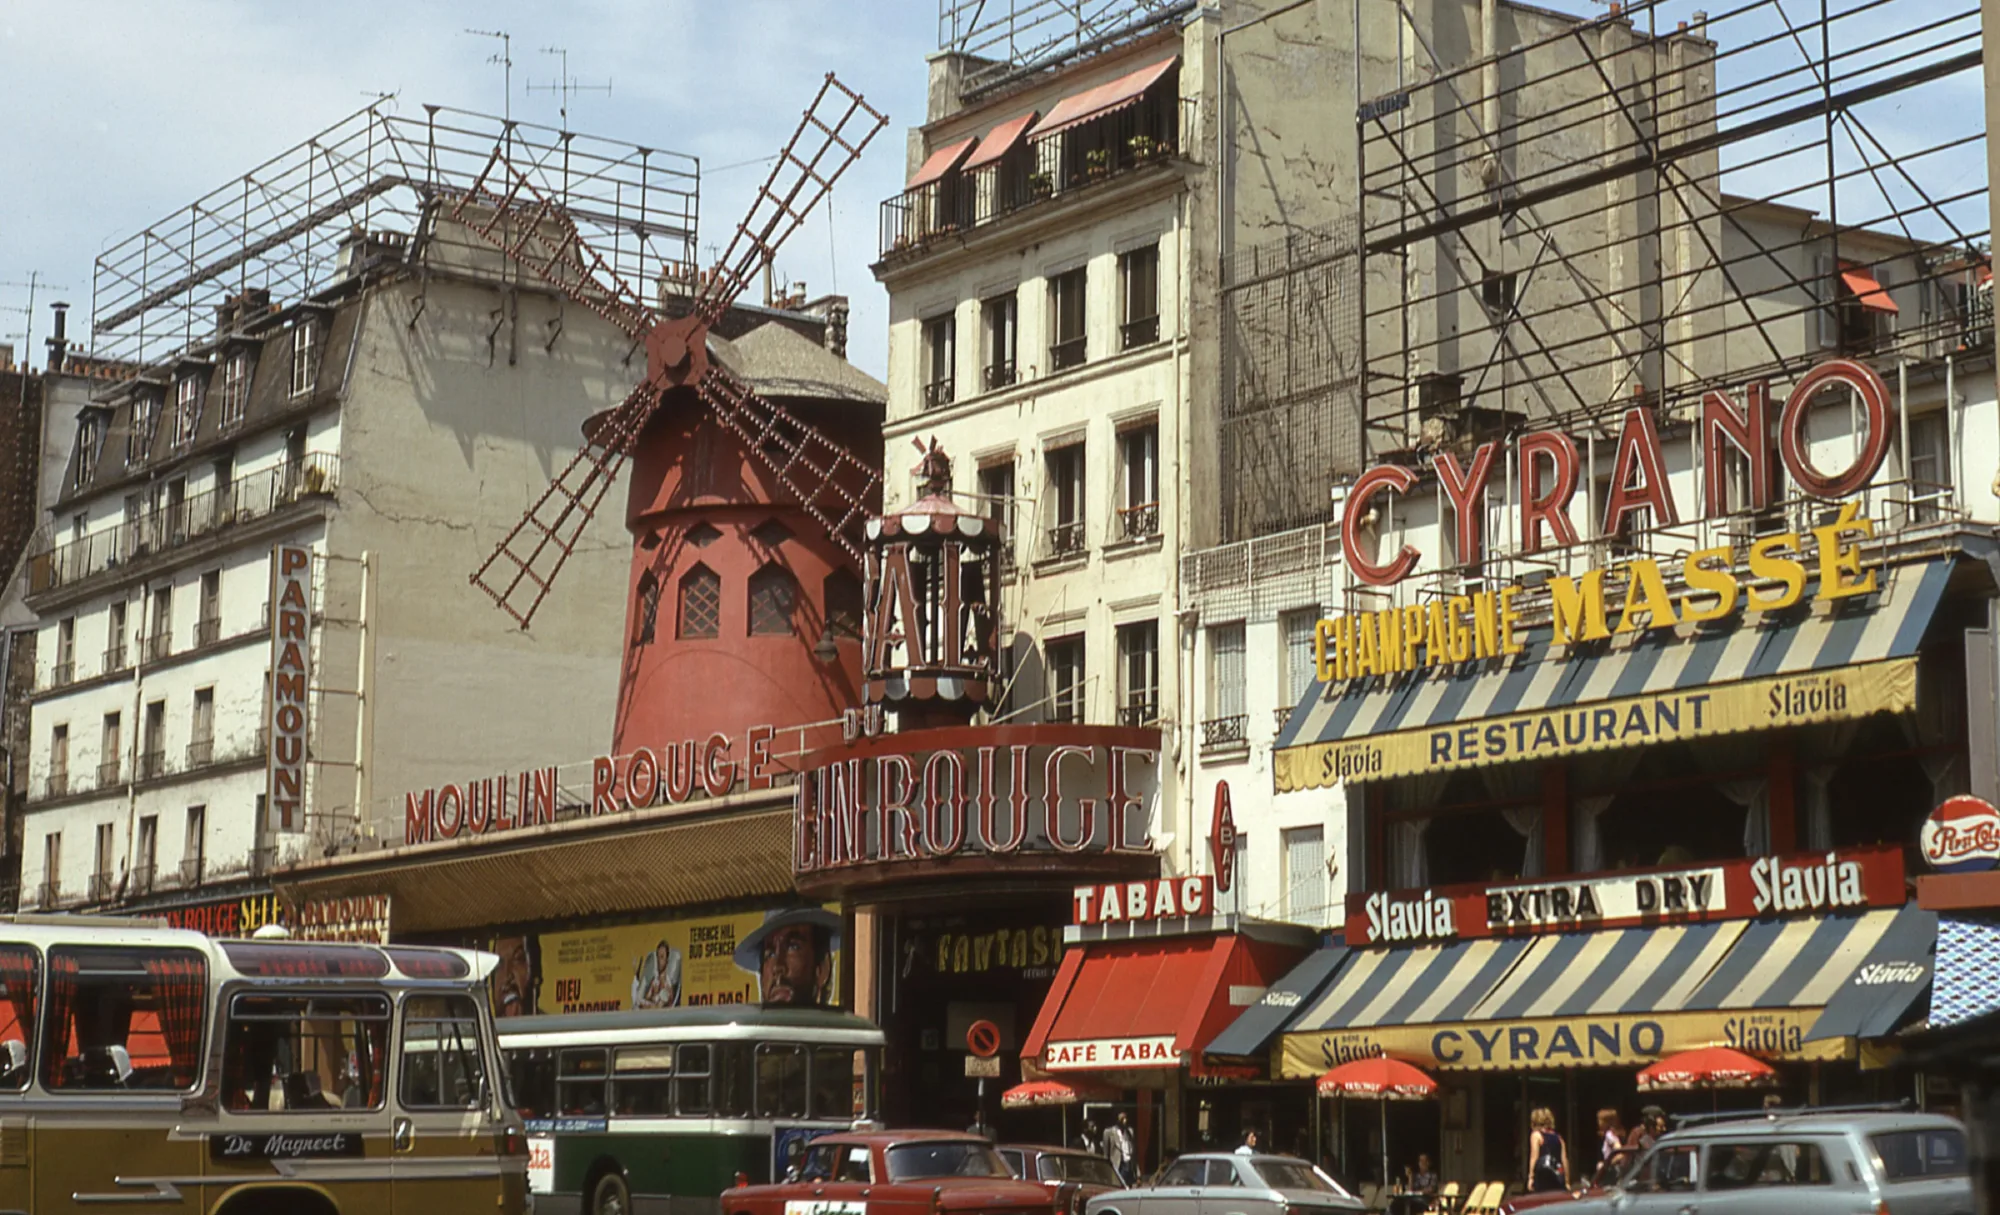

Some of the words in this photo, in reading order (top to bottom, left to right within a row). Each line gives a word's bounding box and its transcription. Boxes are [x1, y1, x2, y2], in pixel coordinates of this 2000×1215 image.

[1341, 357, 1894, 587] CYRANO
[1314, 584, 1524, 684] CHAMPAGNE
[1548, 500, 1878, 648] MASSÉ
[276, 548, 308, 829] PARAMOUNT
[1768, 677, 1846, 719] Slavia
[843, 704, 883, 740] DU
[1430, 694, 1711, 765] RESTAURANT
[1322, 744, 1382, 779] Slavia
[406, 766, 557, 846] MOULIN
[593, 725, 776, 815] ROUGE
[876, 744, 1155, 857] ROUGE
[184, 903, 239, 932] ROUGE
[1073, 877, 1202, 923] TABAC
[1365, 889, 1455, 942] Slavia
[1487, 884, 1602, 922] EXTRA
[1635, 873, 1713, 911] DRY
[1750, 852, 1863, 912] Slavia
[555, 978, 581, 1003] DIEU
[1855, 962, 1925, 986] Slavia
[1045, 1043, 1097, 1063] CAFÉ
[1431, 1020, 1664, 1063] CYRANO
[1723, 1017, 1802, 1053] Slavia
[224, 1134, 252, 1155] De
[264, 1133, 345, 1157] Magneet
